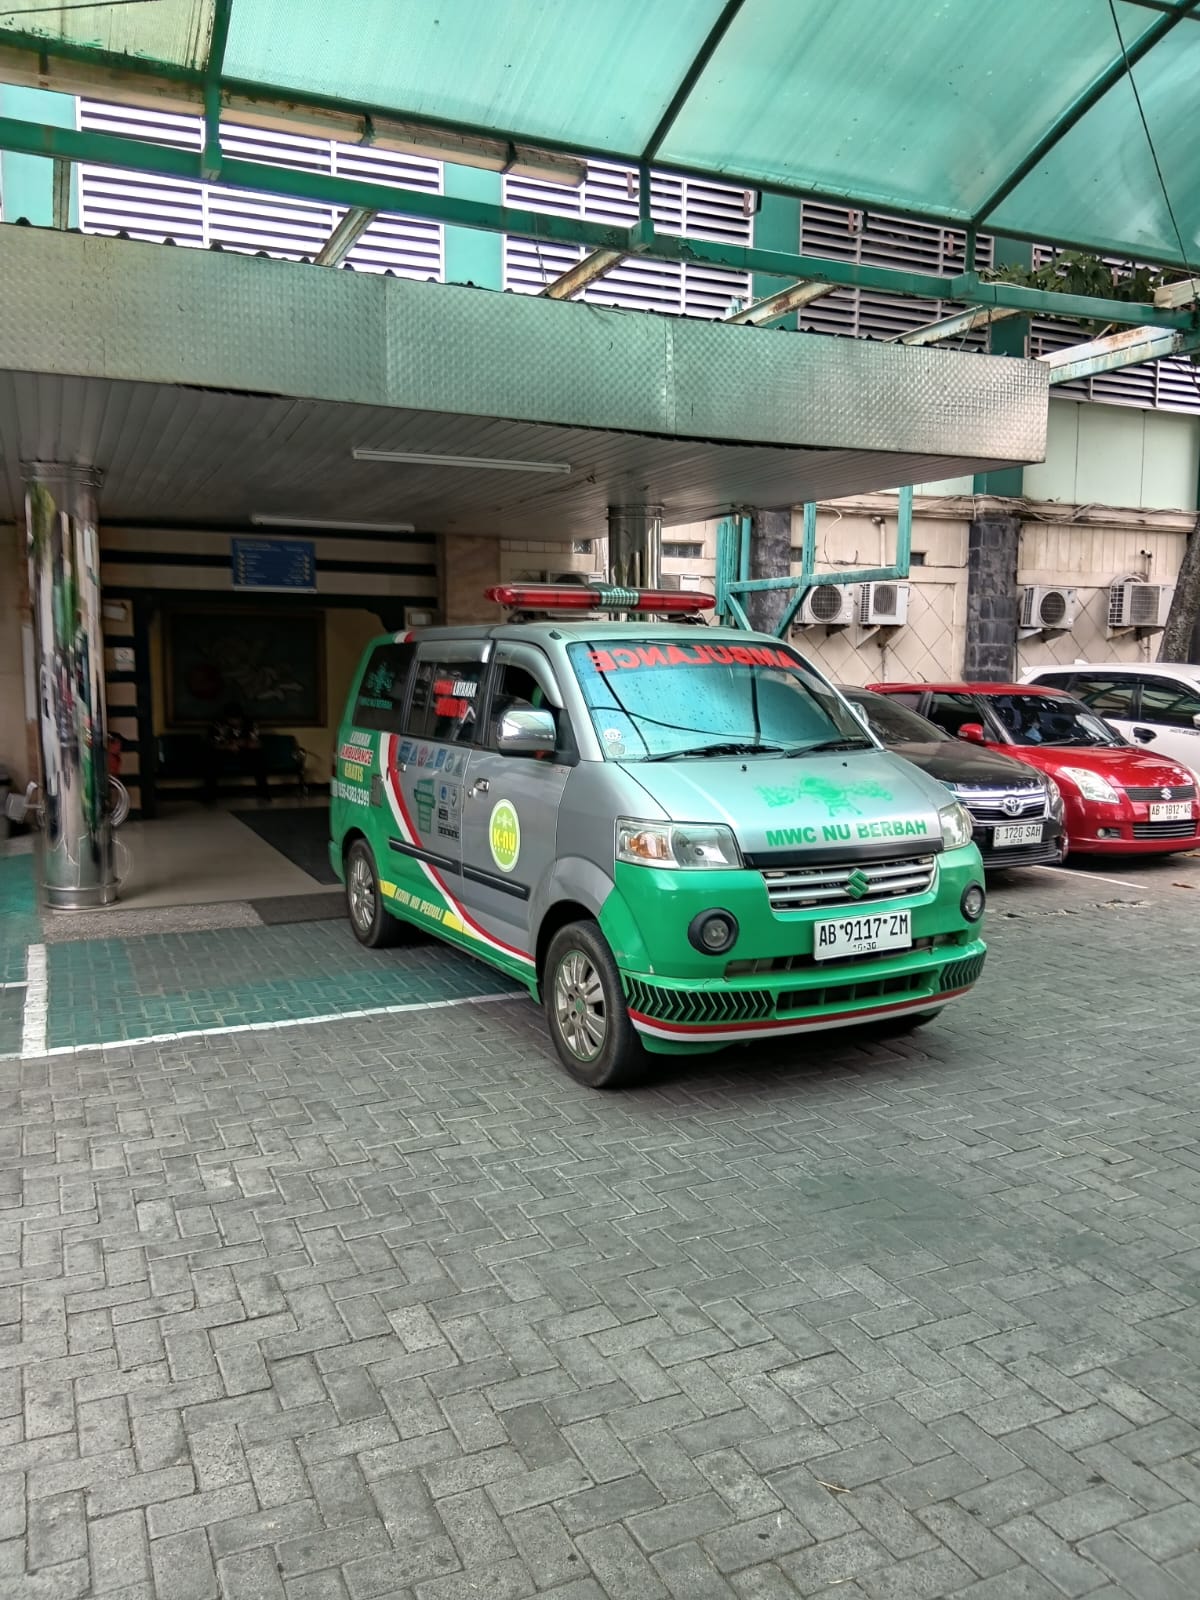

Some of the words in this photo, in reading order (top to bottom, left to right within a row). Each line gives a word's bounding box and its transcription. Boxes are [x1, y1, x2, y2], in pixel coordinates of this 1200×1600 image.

[340, 743, 374, 766] AMBULANCE
[765, 827, 817, 847] MWC
[822, 823, 851, 842] NU
[856, 819, 928, 839] BERBAH
[995, 828, 1001, 840] B
[1004, 827, 1024, 839] 1720
[1025, 826, 1041, 838] SAH
[819, 924, 837, 946] AB
[844, 917, 882, 942] 9117
[890, 914, 908, 936] ZM
